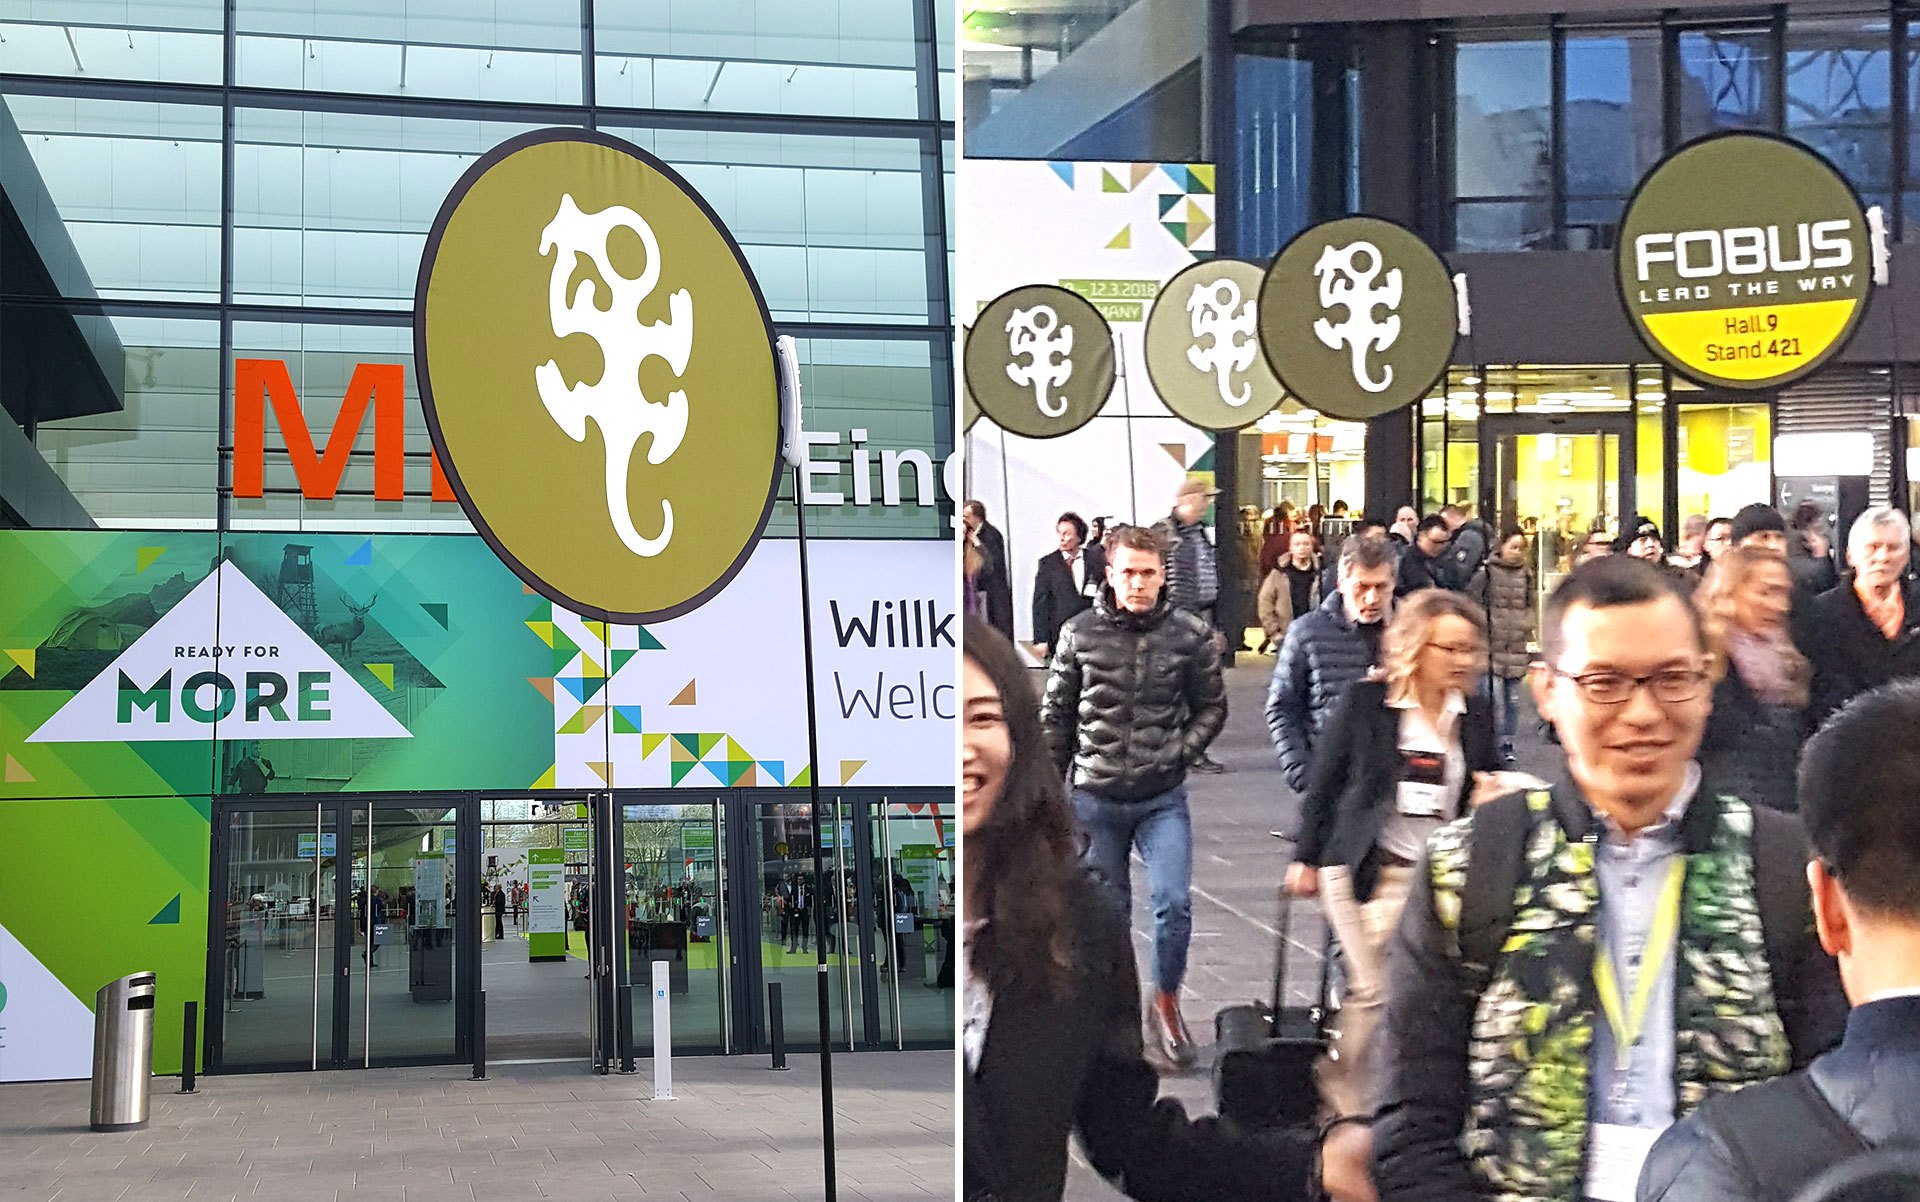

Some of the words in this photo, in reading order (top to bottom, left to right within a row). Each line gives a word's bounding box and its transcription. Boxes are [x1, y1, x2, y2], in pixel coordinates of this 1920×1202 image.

[1635, 219, 1853, 281] FOBUS
[1639, 286, 1710, 303] LEAD
[1728, 281, 1779, 296] THE
[1797, 274, 1855, 292] WAY
[174, 646, 236, 657] READY
[243, 646, 279, 657] FOR
[116, 667, 331, 723] MORE
